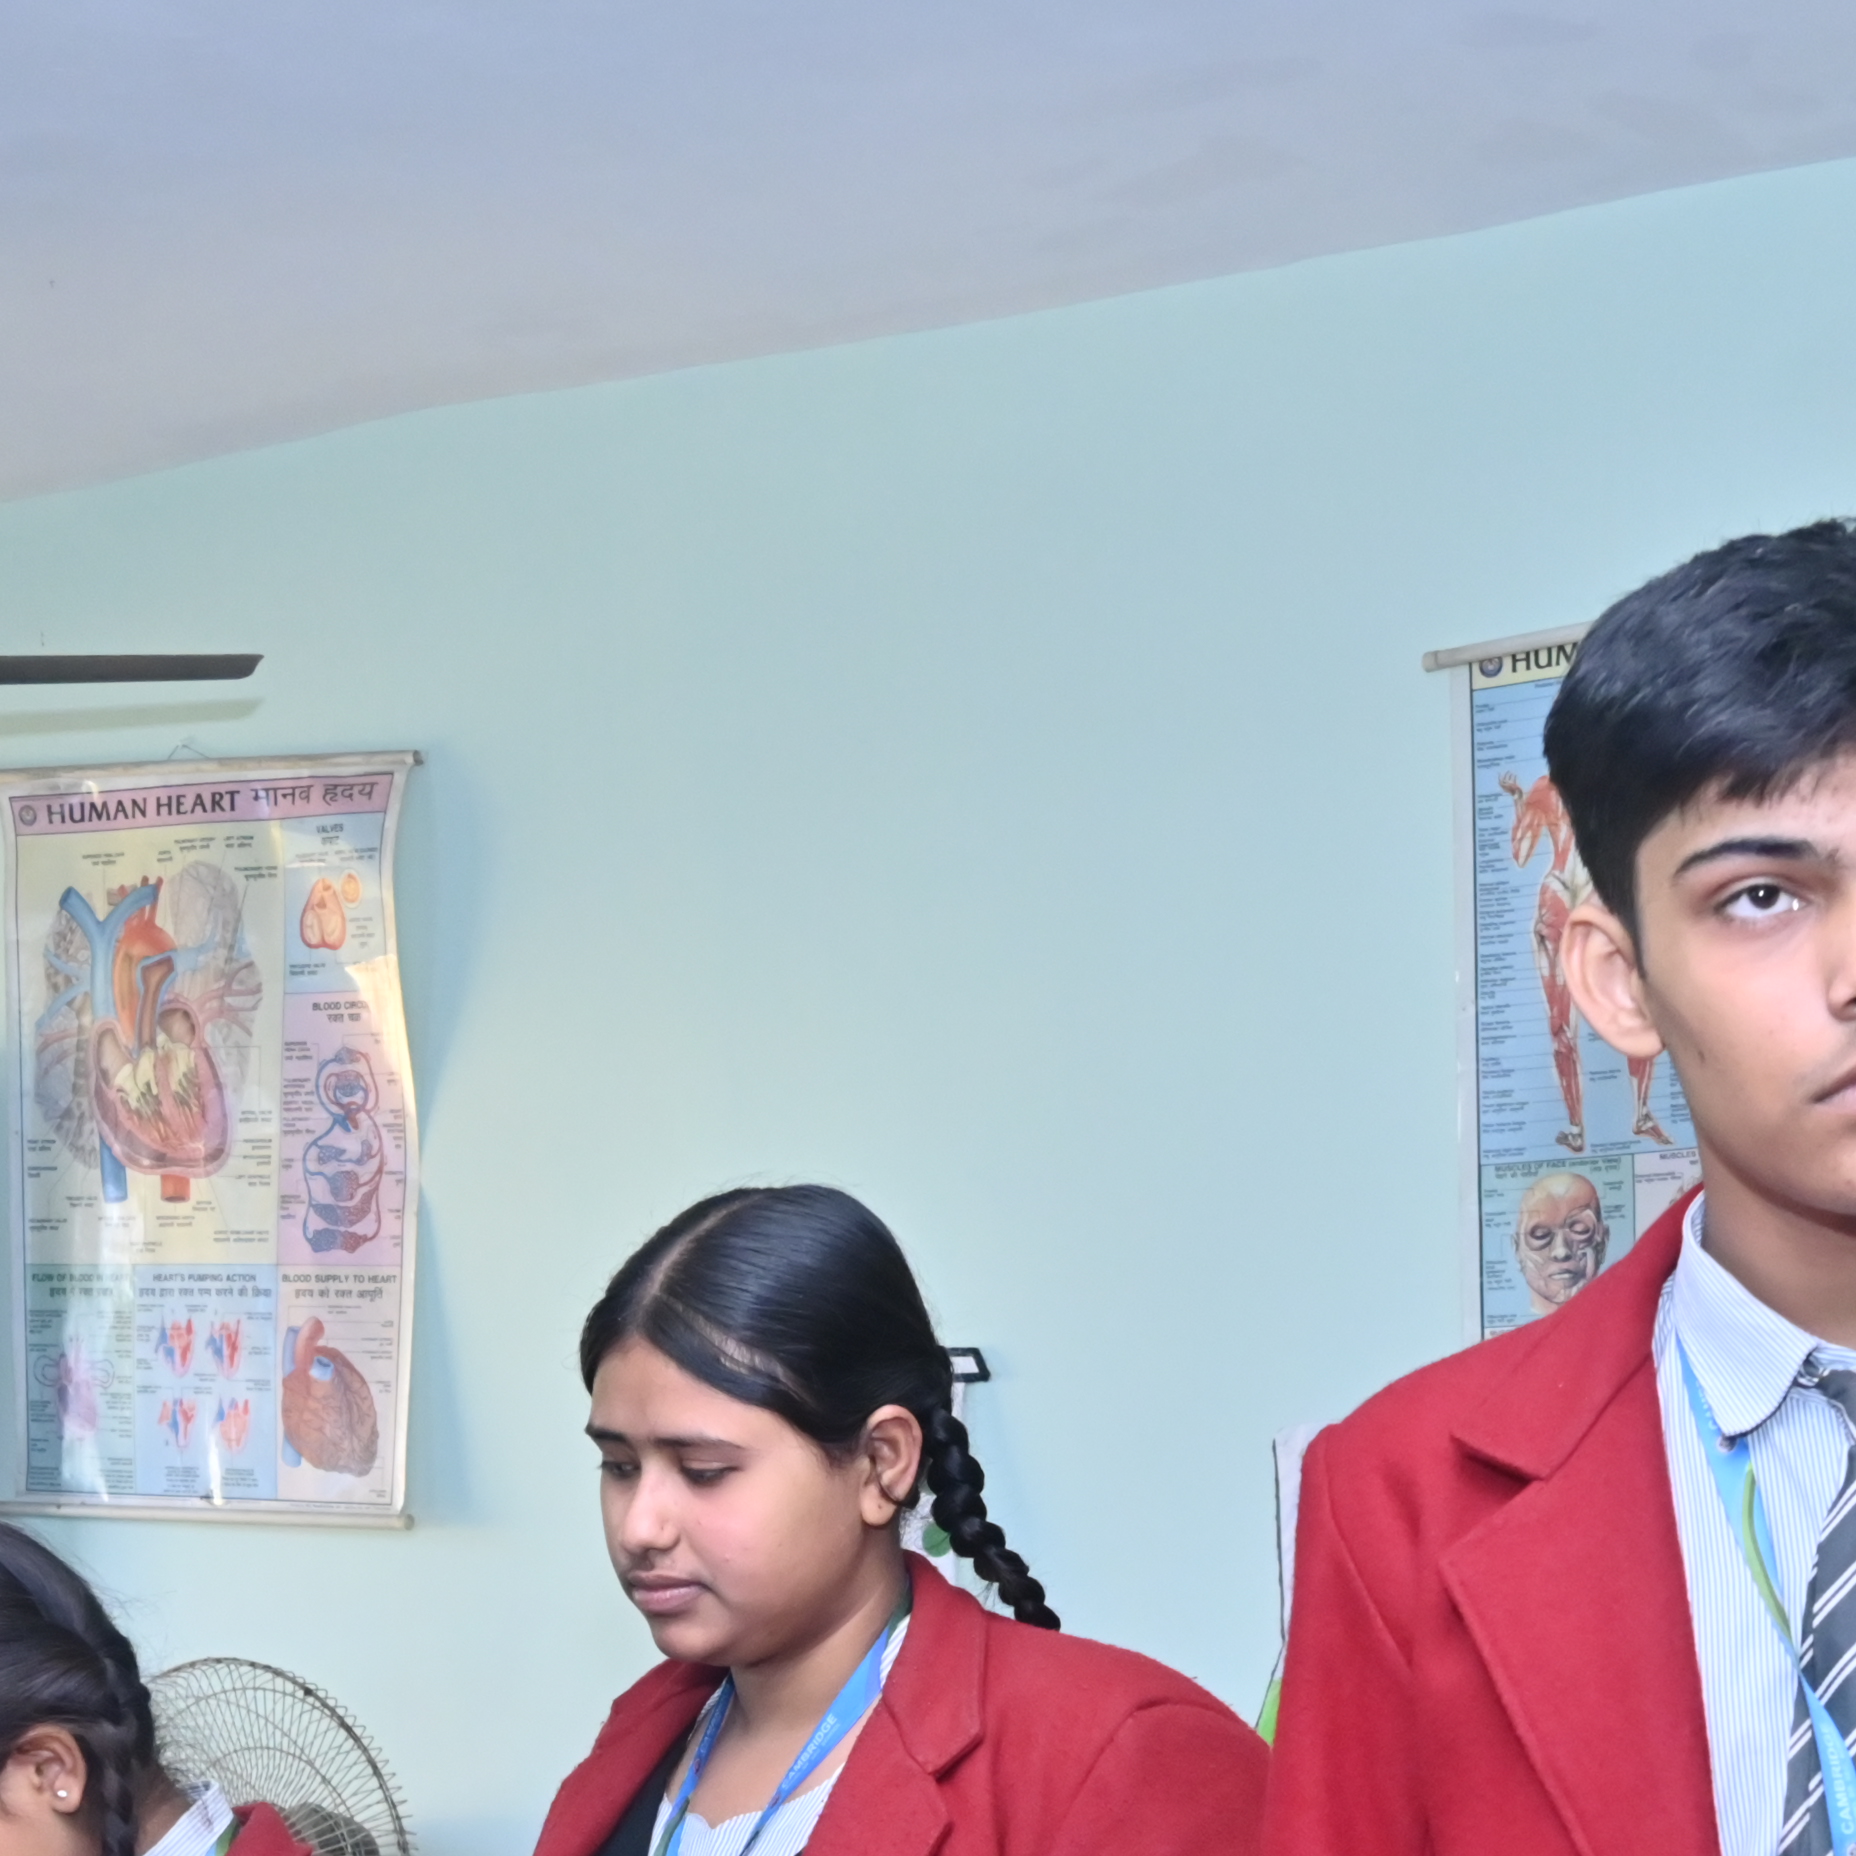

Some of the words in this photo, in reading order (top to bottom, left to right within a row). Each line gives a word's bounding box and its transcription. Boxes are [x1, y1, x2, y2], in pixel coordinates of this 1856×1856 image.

[251, 785, 312, 806] मानव
[322, 782, 378, 805] हृदय
[47, 797, 147, 825] HUMAN
[156, 790, 241, 816] HEART
[316, 823, 343, 834] VALVES
[313, 1001, 342, 1012] BLOOD
[1659, 1151, 1697, 1161] MUSCLES
[1495, 1163, 1533, 1172] MUSCLES
[1546, 1160, 1567, 1169] FACE
[32, 1273, 55, 1283] FLOW
[56, 1273, 67, 1283] OF
[69, 1273, 95, 1283] BLOOD
[153, 1272, 186, 1283] HEART'S
[187, 1273, 224, 1283] PUMPING
[225, 1273, 257, 1283] ACTION
[282, 1274, 312, 1284] BLOOD
[315, 1274, 350, 1284] SUPPLY
[352, 1274, 364, 1283] TO
[366, 1274, 397, 1283] HEART
[782, 1713, 838, 1788] CAMBRIDGE
[1819, 1723, 1854, 1835] CAMBRIDGE
